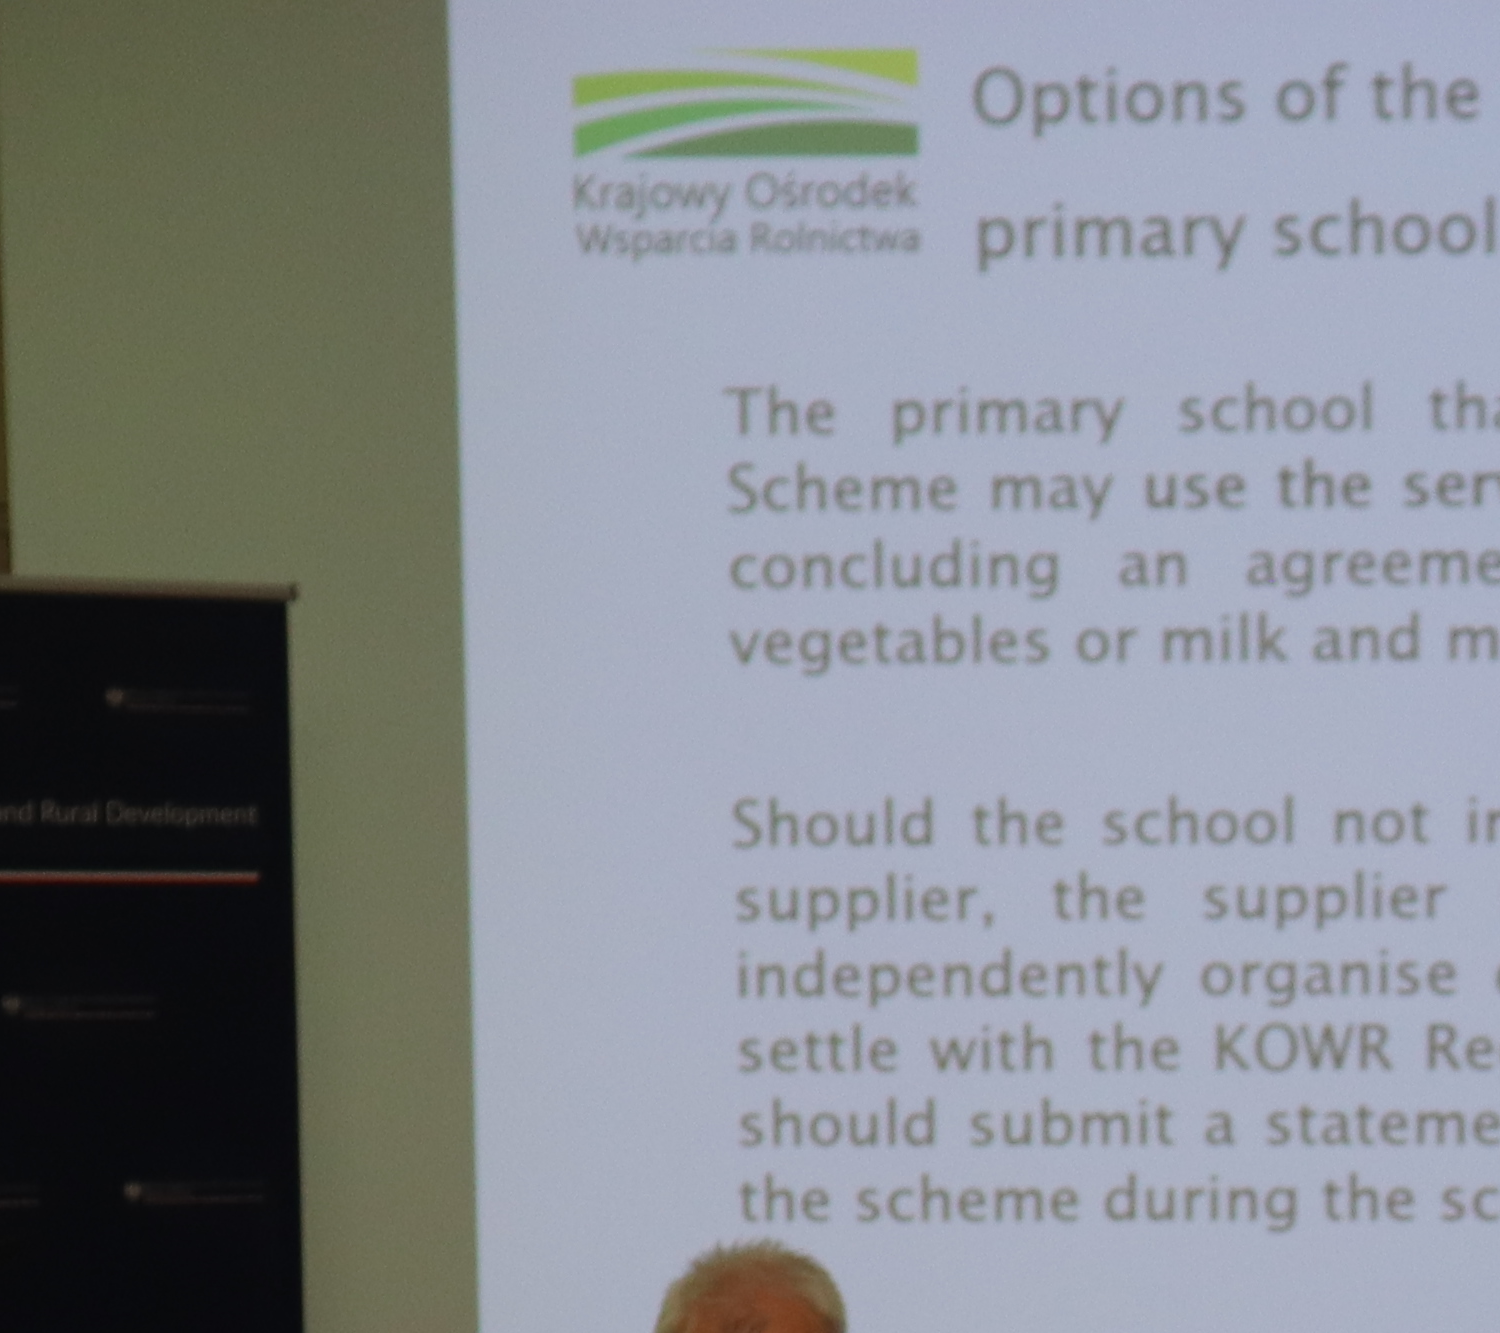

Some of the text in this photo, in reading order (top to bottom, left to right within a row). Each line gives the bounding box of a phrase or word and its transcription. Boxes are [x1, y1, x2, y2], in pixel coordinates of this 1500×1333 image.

[971, 65, 1247, 139] Options
[1274, 61, 1349, 124] of
[1370, 61, 1481, 123] the
[571, 171, 918, 219] Krajowy Ośrodek
[576, 221, 922, 261] Wsparcia Rolnictwa
[976, 195, 1497, 274] primary school
[723, 384, 836, 437] The
[892, 387, 1125, 447] primary
[1179, 380, 1374, 435] school
[727, 461, 958, 516] Scheme
[990, 474, 1114, 522] may
[1144, 472, 1247, 511] use
[1276, 457, 1373, 510] the
[728, 538, 1060, 601] concluding
[1118, 551, 1188, 589] an
[729, 613, 1051, 678] vegetables
[1074, 627, 1138, 665] or
[1161, 611, 1288, 663] milk
[1312, 611, 1421, 663] and
[41, 799, 99, 826] Rural
[106, 799, 258, 829] Development
[731, 796, 935, 851] Should
[971, 796, 1065, 848] the
[1102, 794, 1295, 847] school
[1333, 802, 1429, 846] not
[735, 872, 995, 933] supplier,
[1052, 870, 1146, 922] the
[1203, 869, 1448, 931] supplier
[737, 947, 1164, 1009] independently
[1199, 949, 1458, 1009] organise
[738, 1023, 899, 1075] settle
[929, 1022, 1055, 1074] with
[1087, 1021, 1181, 1073] the
[1214, 1021, 1393, 1074] KOWR
[739, 1097, 937, 1149] should
[969, 1097, 1174, 1148] submit
[1204, 1110, 1236, 1147] a
[739, 1173, 831, 1223] the
[856, 1173, 1080, 1224] scheme
[1103, 1172, 1299, 1235] during
[1322, 1172, 1416, 1223] the
